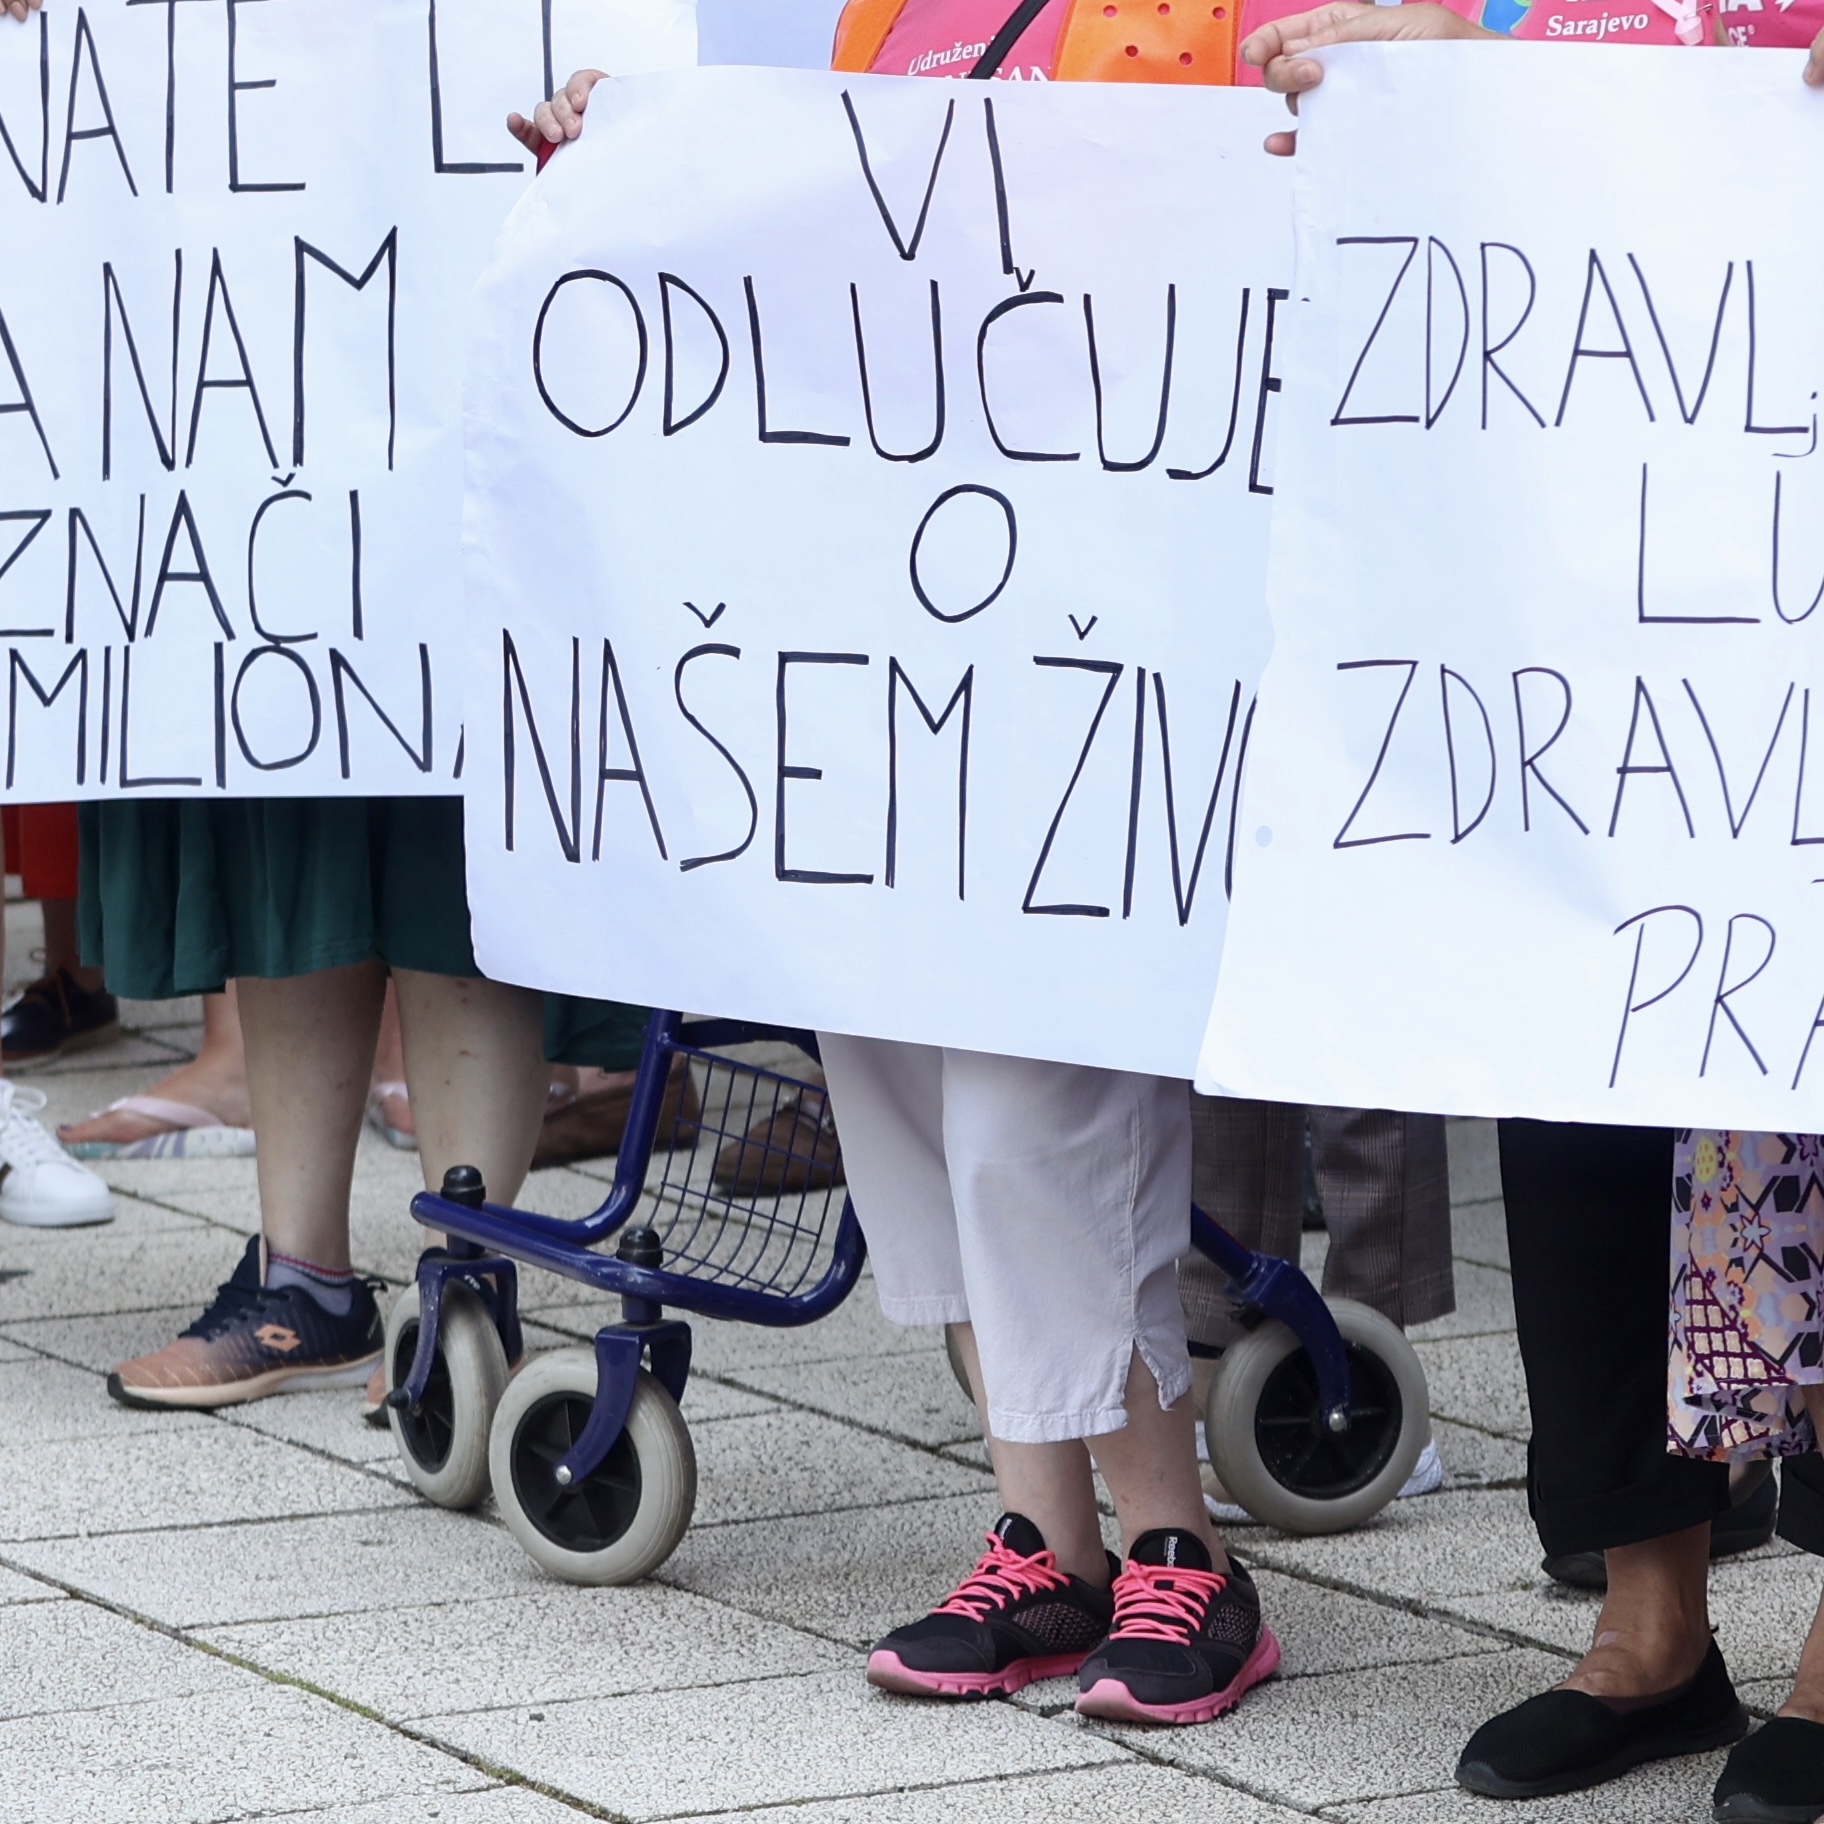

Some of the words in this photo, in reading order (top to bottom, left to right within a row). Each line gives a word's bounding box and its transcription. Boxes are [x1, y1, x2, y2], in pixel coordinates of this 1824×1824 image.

[907, 35, 995, 76] Udružen
[1545, 12, 1649, 40] Sarajevo
[841, 89, 1015, 275] VI
[102, 225, 399, 482] NAM
[909, 483, 1018, 624] O
[6, 641, 465, 789] MILION
[501, 601, 975, 901] NAŠEM
[1166, 1535, 1179, 1568] Reebo
